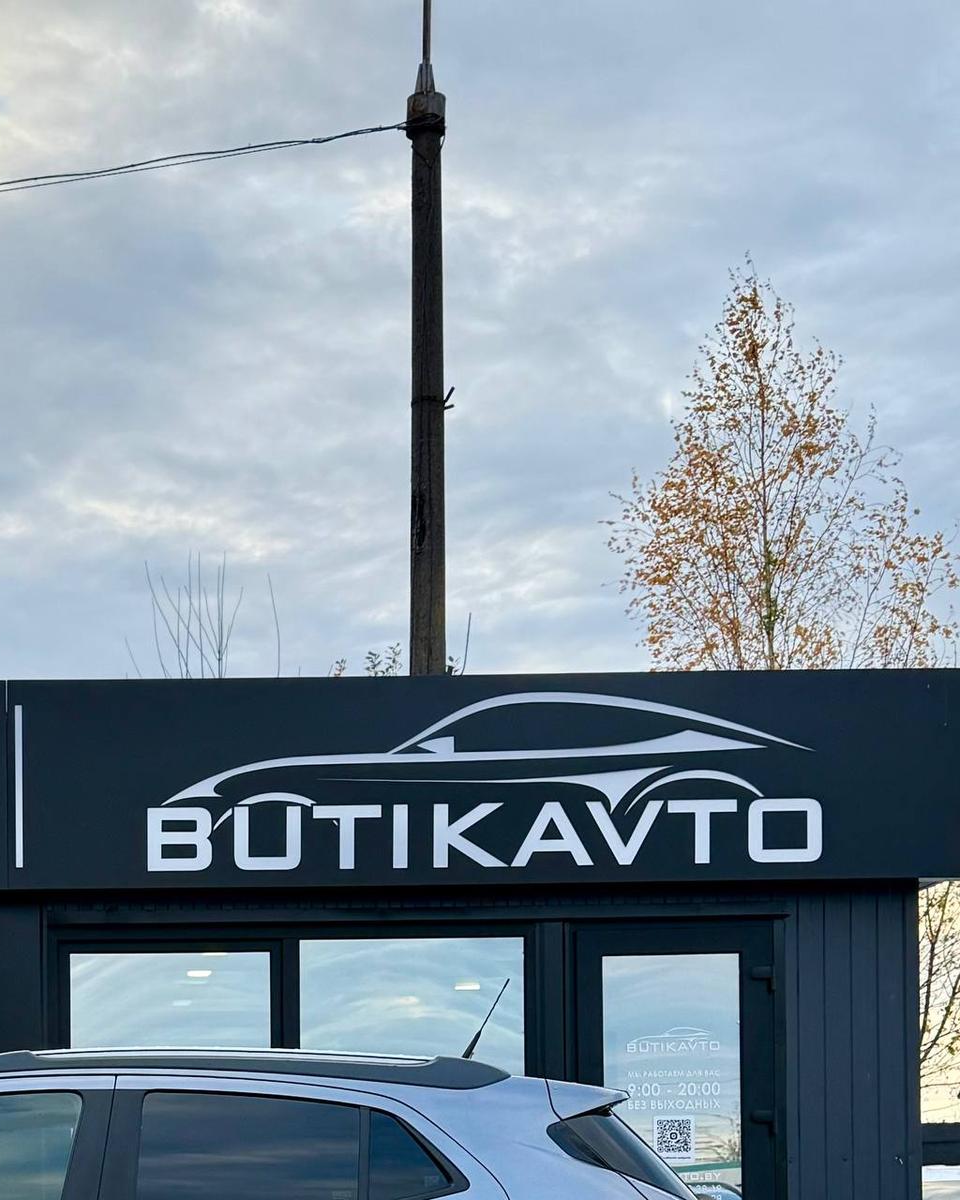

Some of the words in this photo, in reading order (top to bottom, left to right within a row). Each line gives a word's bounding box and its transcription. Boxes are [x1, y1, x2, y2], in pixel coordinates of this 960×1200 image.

[146, 797, 824, 872] BUTIKAVTO
[626, 1041, 720, 1053] BUTIKAVTO
[627, 1083, 660, 1097] 9:00
[678, 1082, 721, 1096] 20:00
[627, 1100, 647, 1110] БЕЗ
[650, 1099, 721, 1110] ВЫХОДНЫХ
